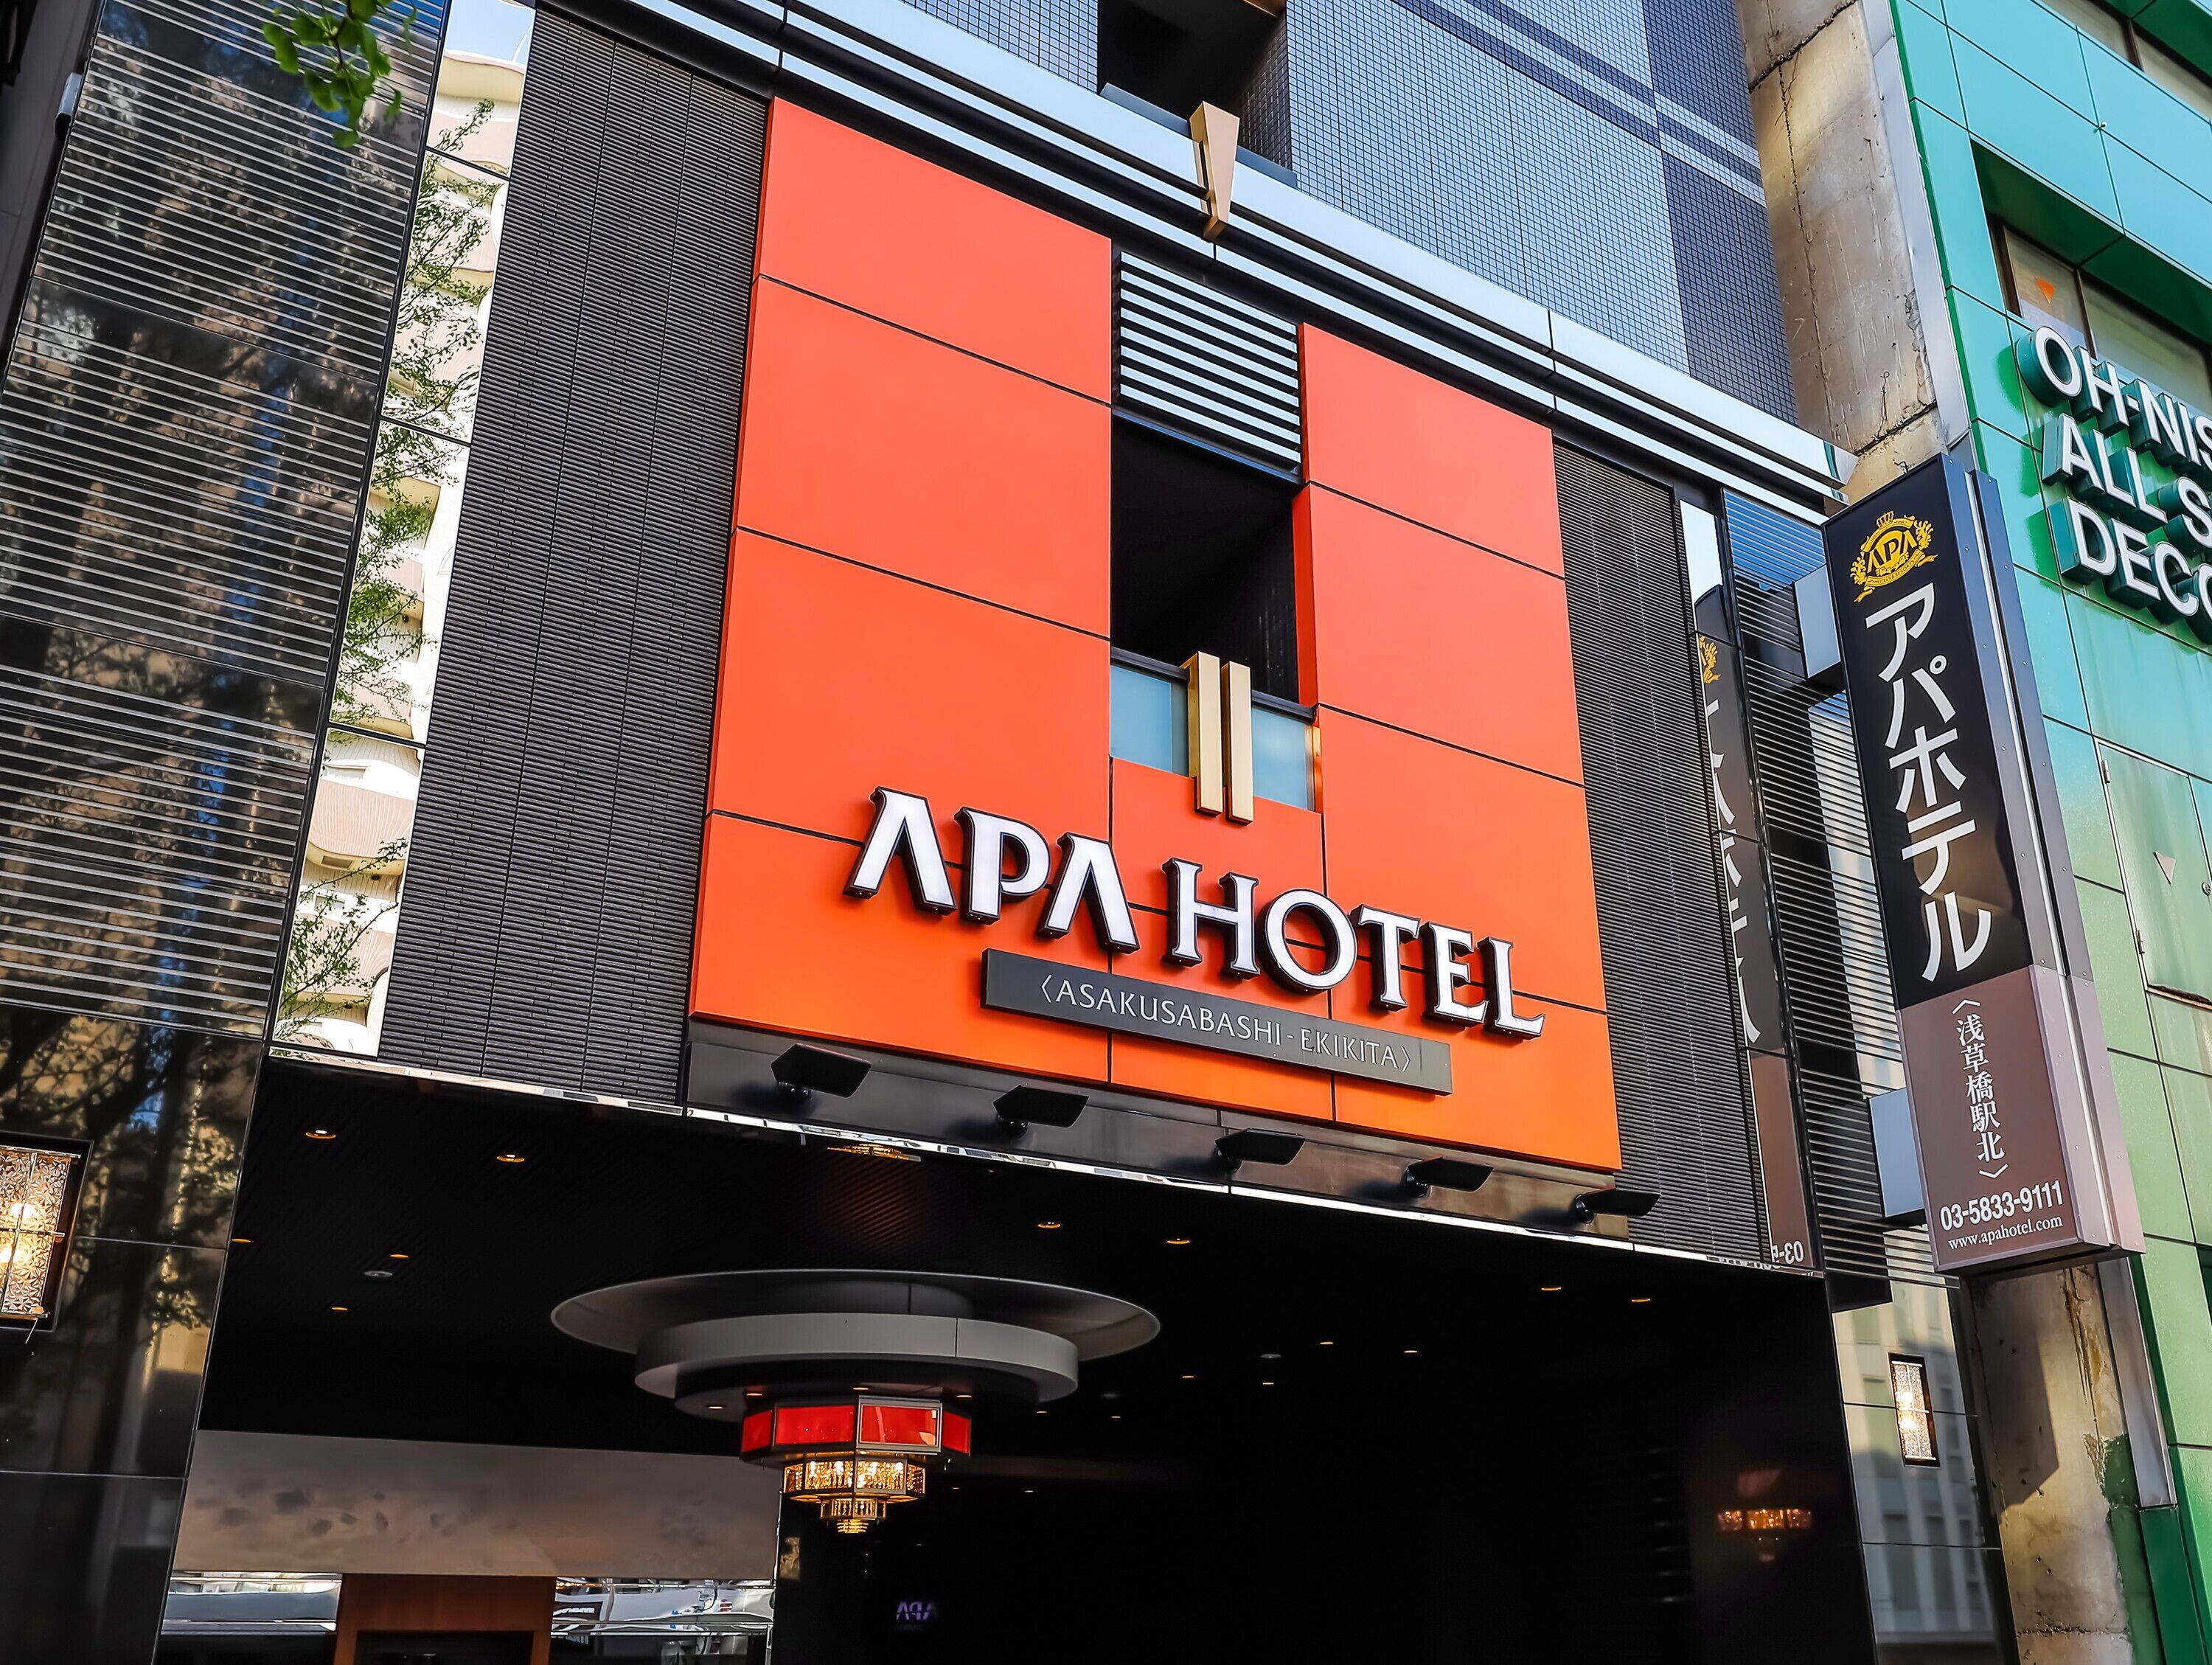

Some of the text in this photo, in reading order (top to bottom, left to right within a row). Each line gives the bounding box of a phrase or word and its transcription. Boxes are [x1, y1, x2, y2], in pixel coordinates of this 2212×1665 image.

[2060, 414, 2168, 524] ALL
[1866, 529, 1918, 574] APA
[1865, 582, 1992, 982] アパホテル
[848, 787, 1138, 952] APA
[1164, 858, 1546, 1040] HOTEL
[1940, 1180, 2064, 1231] 03-5833-9111
[1948, 1215, 2064, 1250] www.apahotel.com
